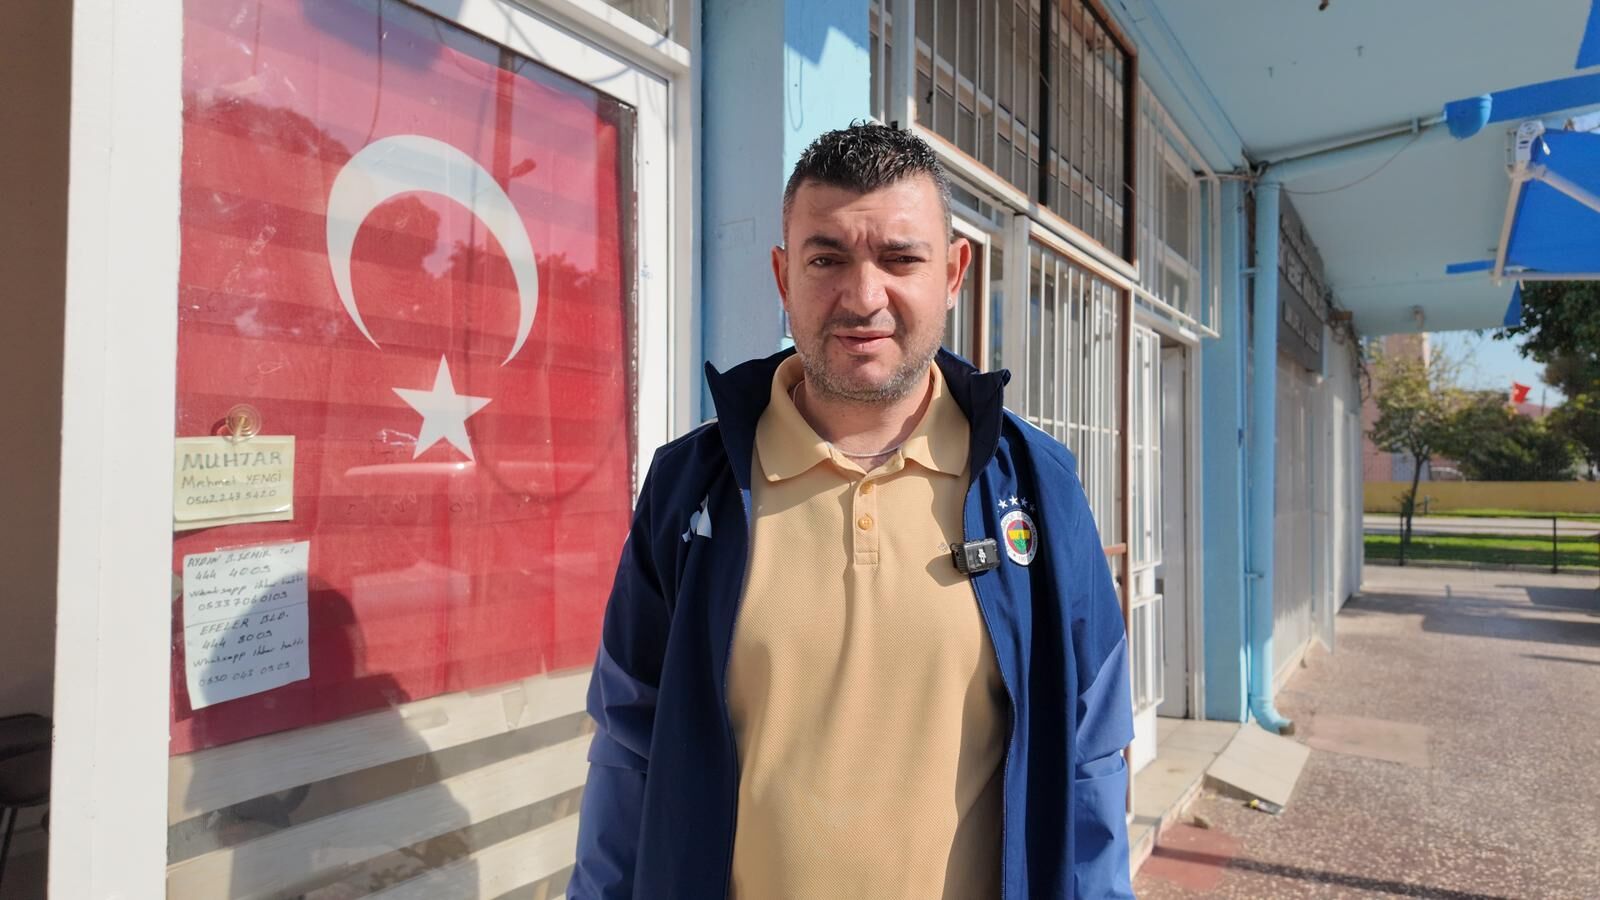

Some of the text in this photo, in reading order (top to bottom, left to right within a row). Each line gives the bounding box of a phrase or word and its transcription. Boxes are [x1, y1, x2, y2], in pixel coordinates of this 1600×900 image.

[182, 451, 281, 471] MUHTAR
[195, 569, 216, 580] 444
[200, 618, 249, 636] EFELER
